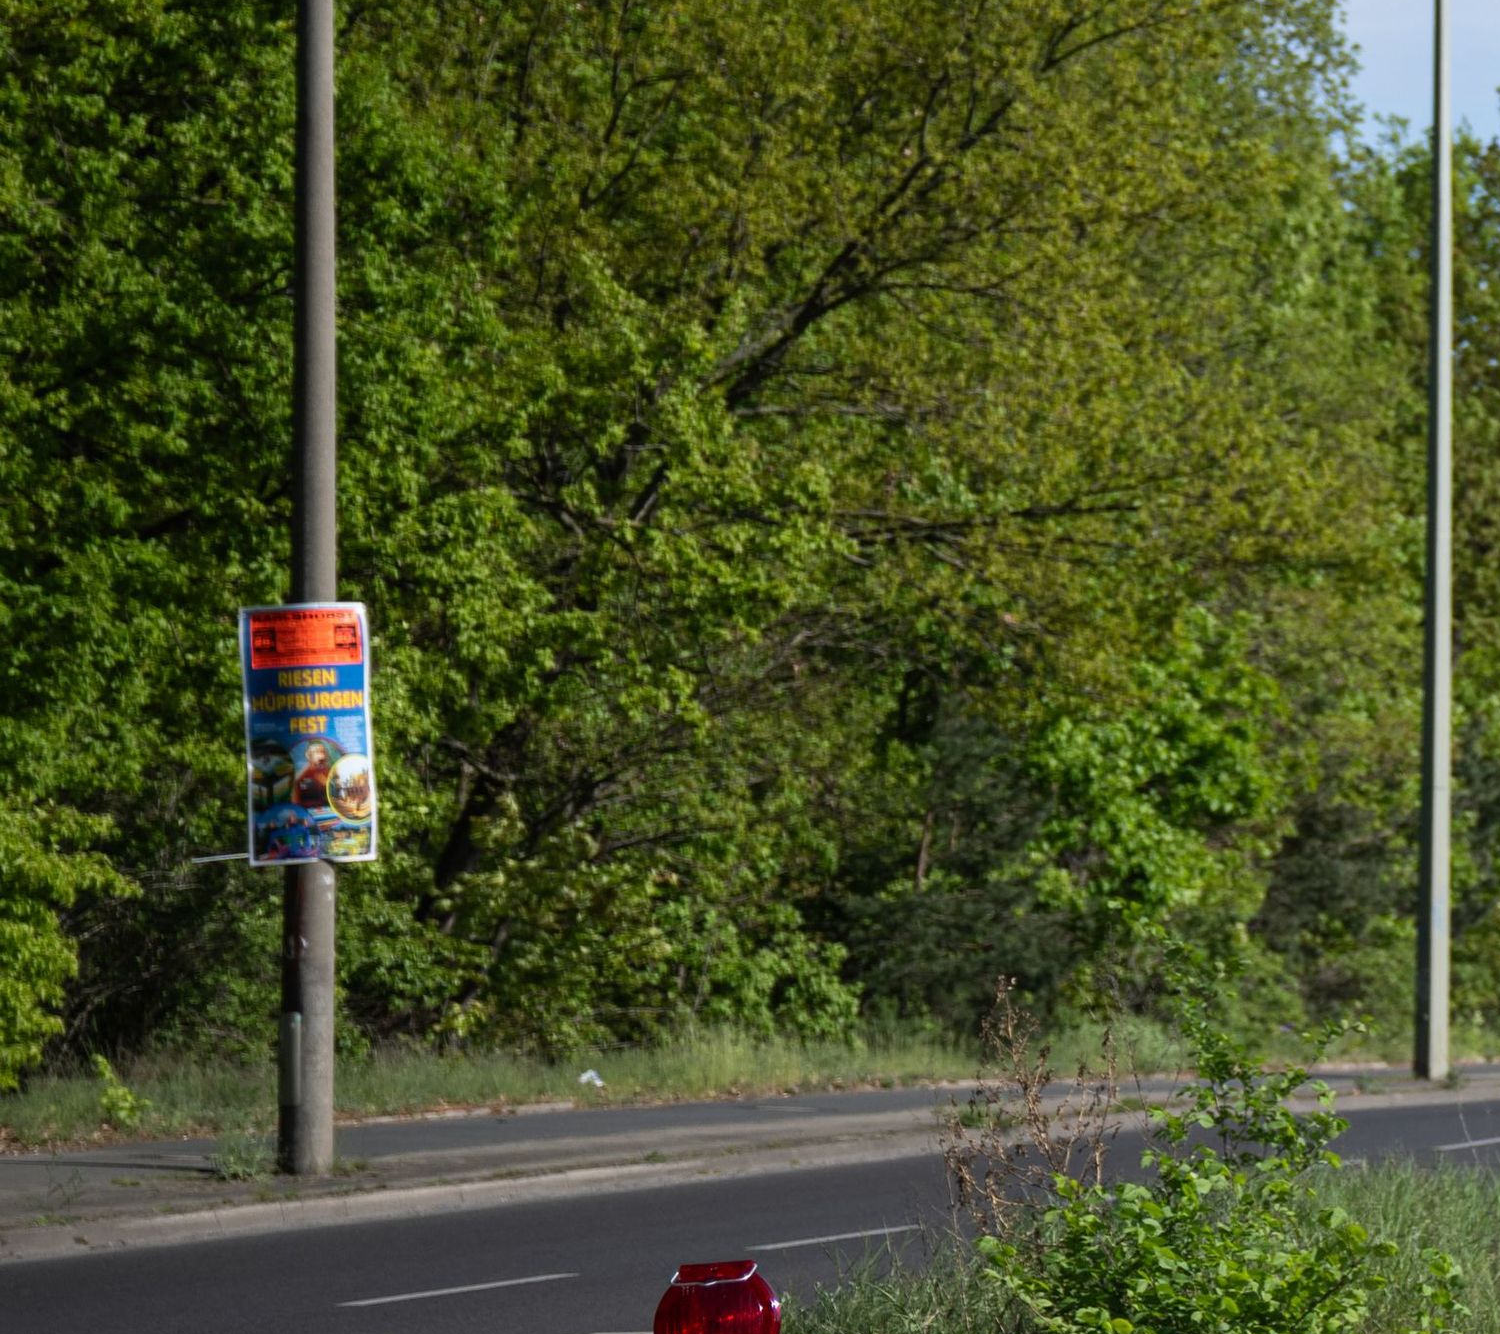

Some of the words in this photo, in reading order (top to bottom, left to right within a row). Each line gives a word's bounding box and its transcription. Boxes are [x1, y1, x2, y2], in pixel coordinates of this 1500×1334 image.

[278, 668, 337, 687] RIESEN
[252, 690, 363, 712] HÜPFBURGEN
[290, 715, 328, 734] FEST
